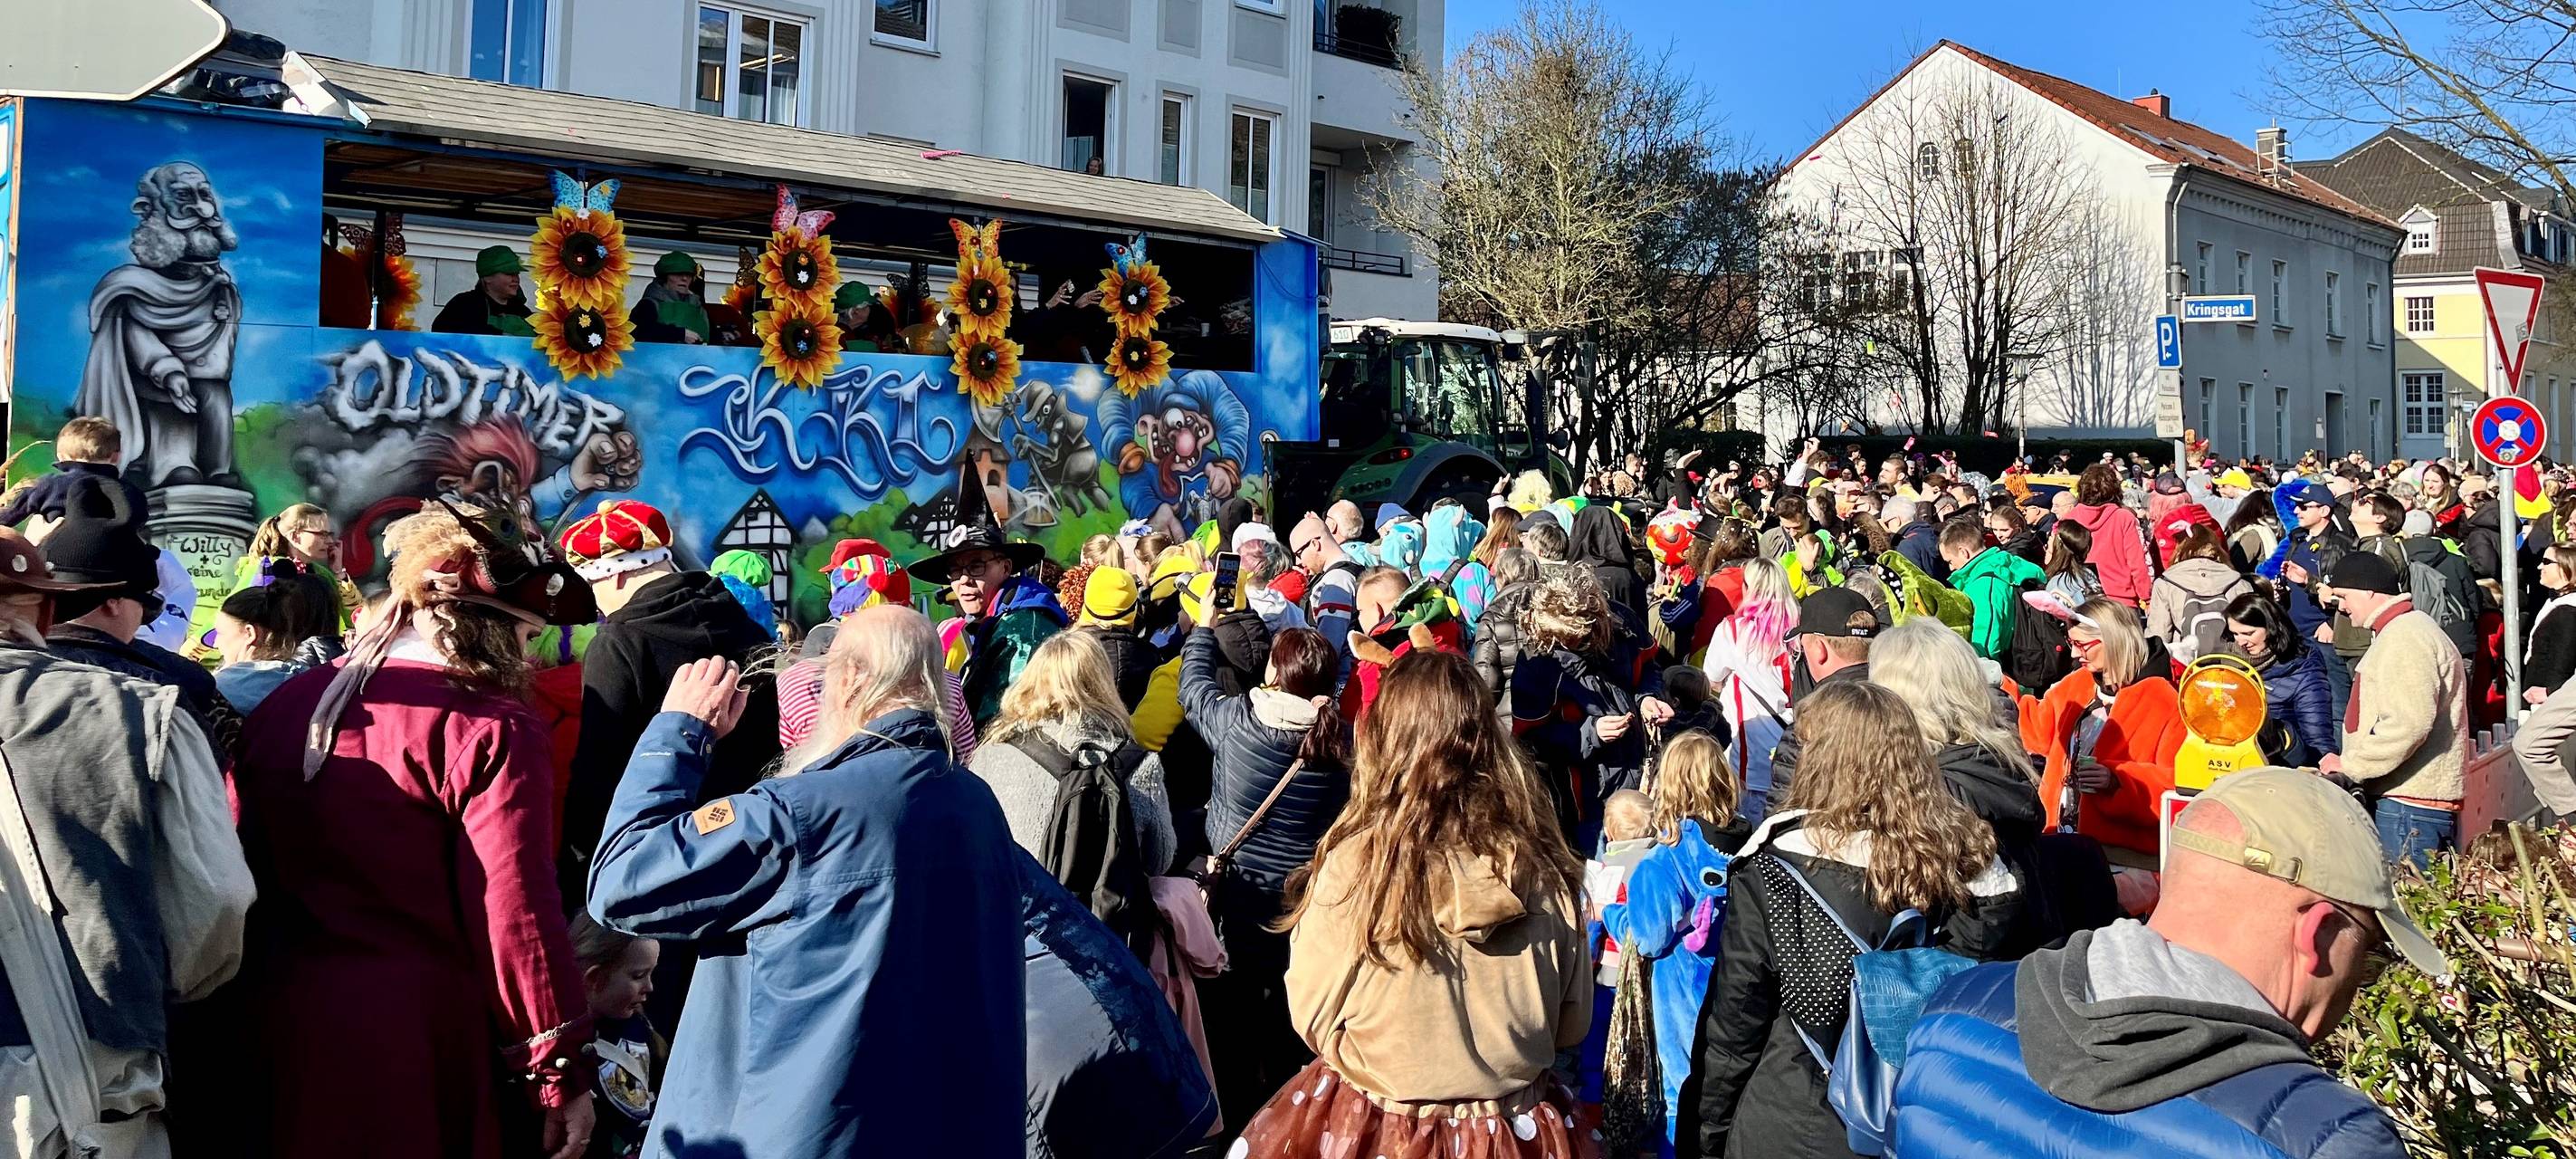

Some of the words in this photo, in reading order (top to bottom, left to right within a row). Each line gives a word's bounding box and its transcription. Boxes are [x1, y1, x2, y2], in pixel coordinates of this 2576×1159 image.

[2187, 302, 2245, 317] Kringsgat
[2161, 322, 2173, 360] P
[2209, 760, 2231, 768] ASV
